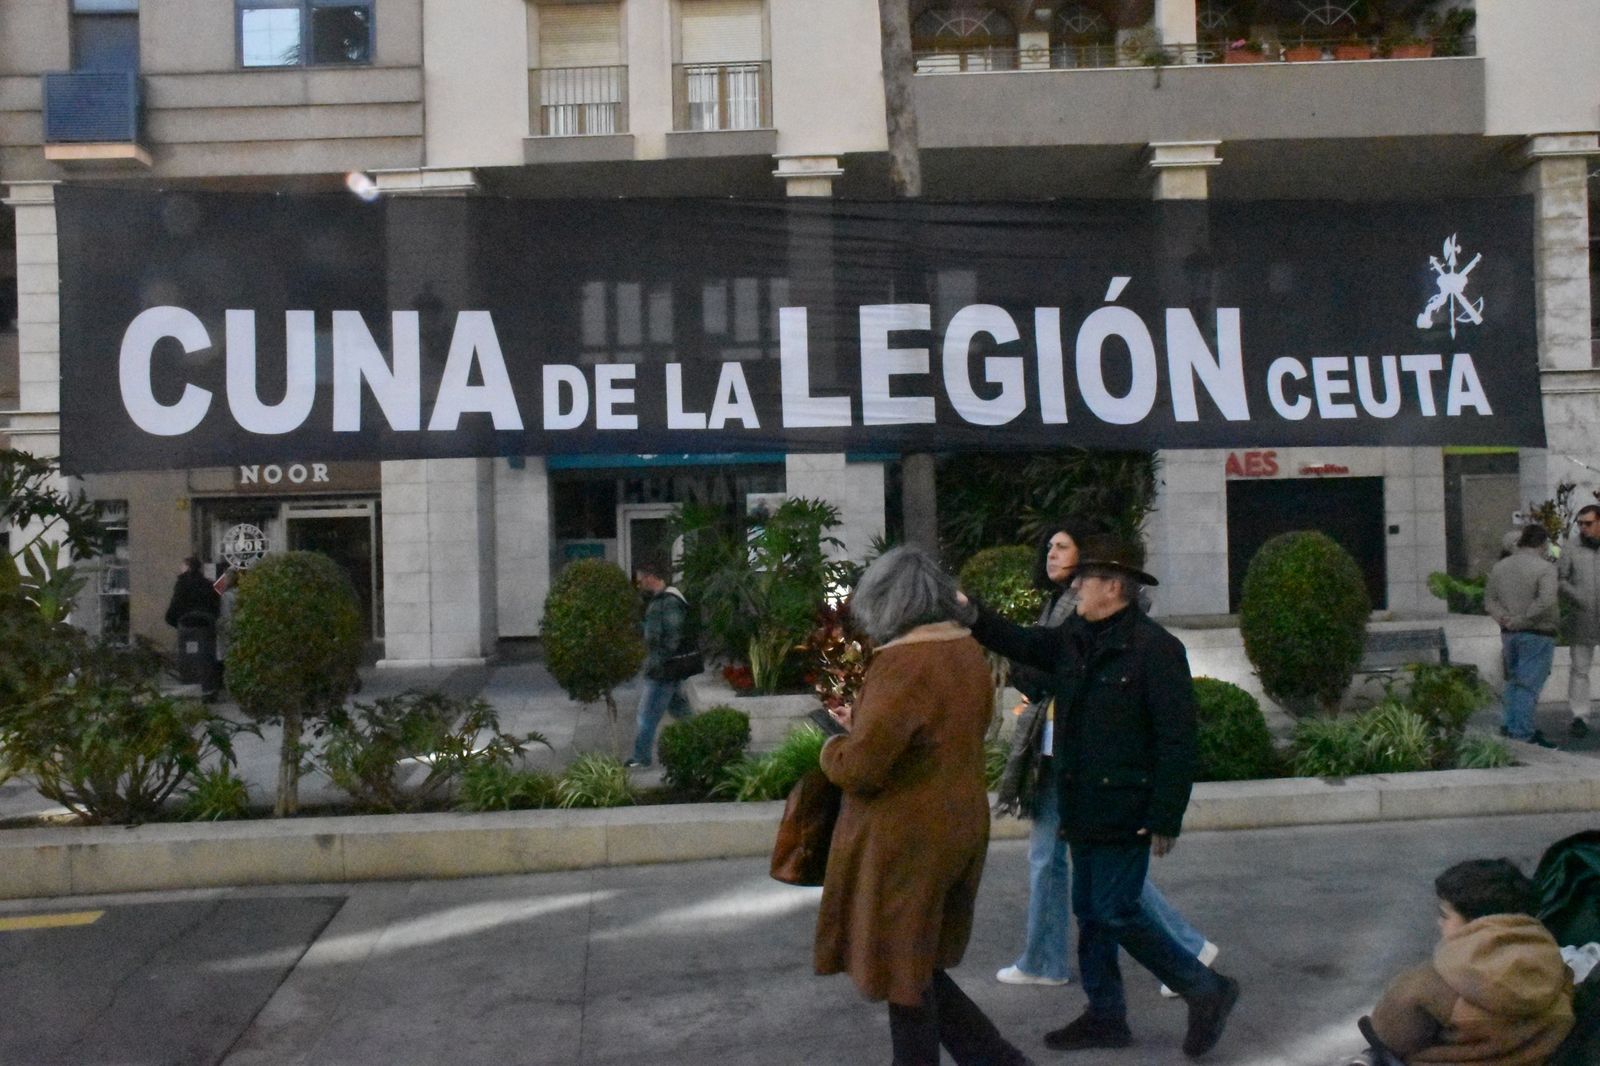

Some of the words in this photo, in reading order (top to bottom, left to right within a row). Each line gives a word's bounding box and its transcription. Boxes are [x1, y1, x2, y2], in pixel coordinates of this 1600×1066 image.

[119, 306, 524, 436] CUNA
[542, 364, 638, 430] DE
[665, 361, 761, 430] LA
[779, 276, 1251, 427] LEGIÓN
[1267, 353, 1493, 421] CEUTA
[240, 463, 330, 484] NOOR
